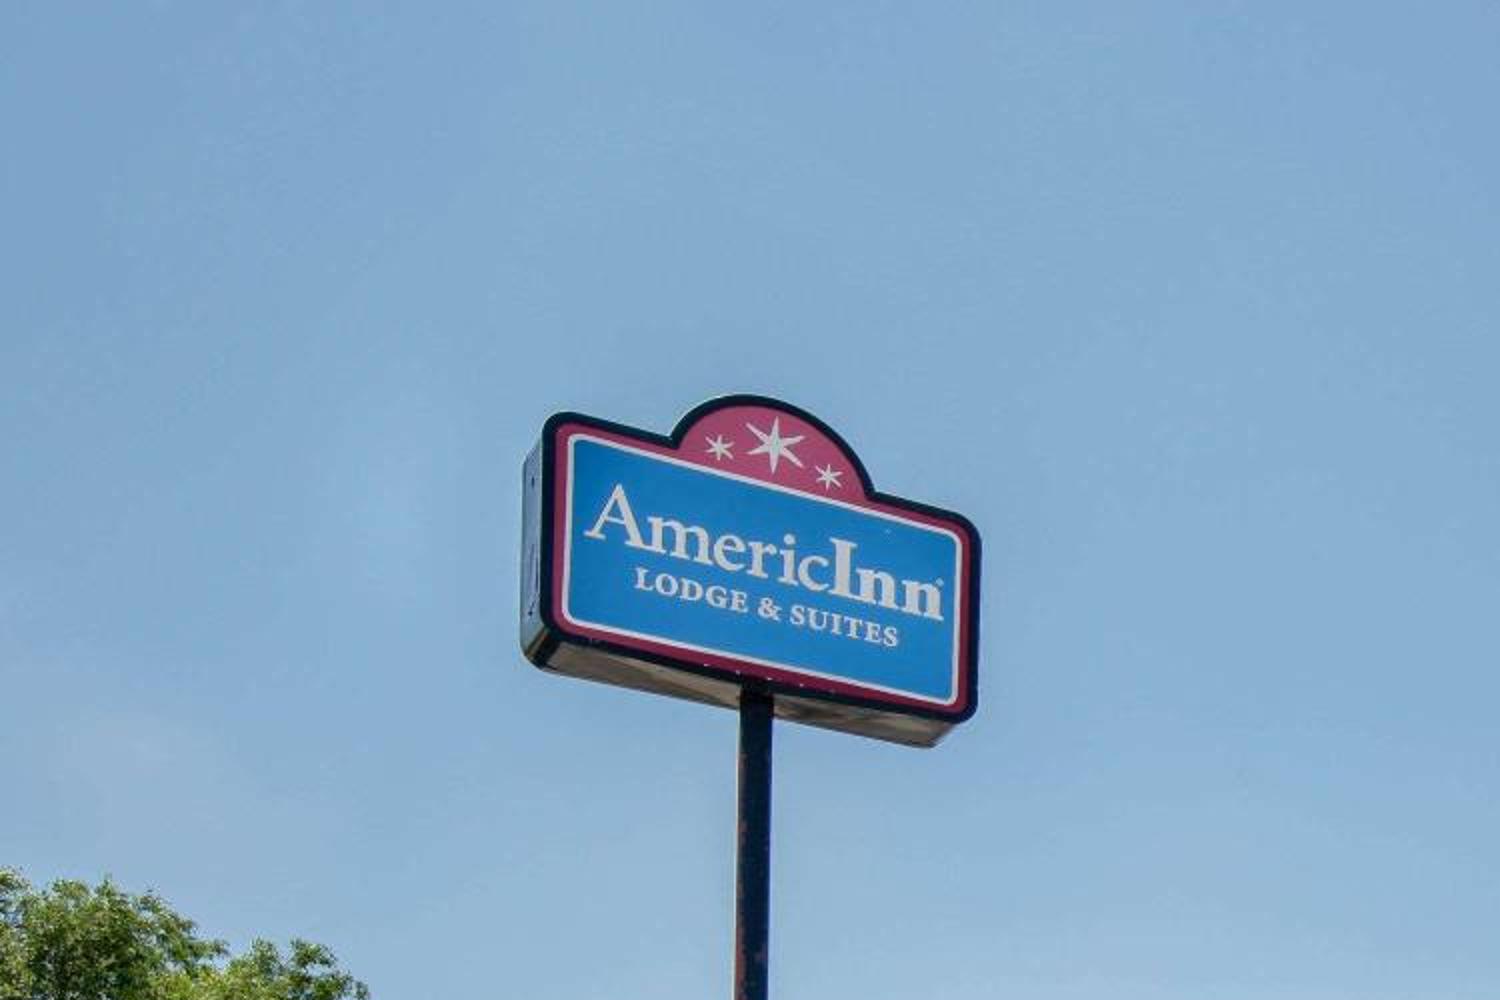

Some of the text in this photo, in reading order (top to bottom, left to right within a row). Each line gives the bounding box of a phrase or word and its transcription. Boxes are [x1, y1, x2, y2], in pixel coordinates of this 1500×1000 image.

[584, 483, 944, 621] AmericInn
[634, 567, 898, 648] LODGE & SUITES
